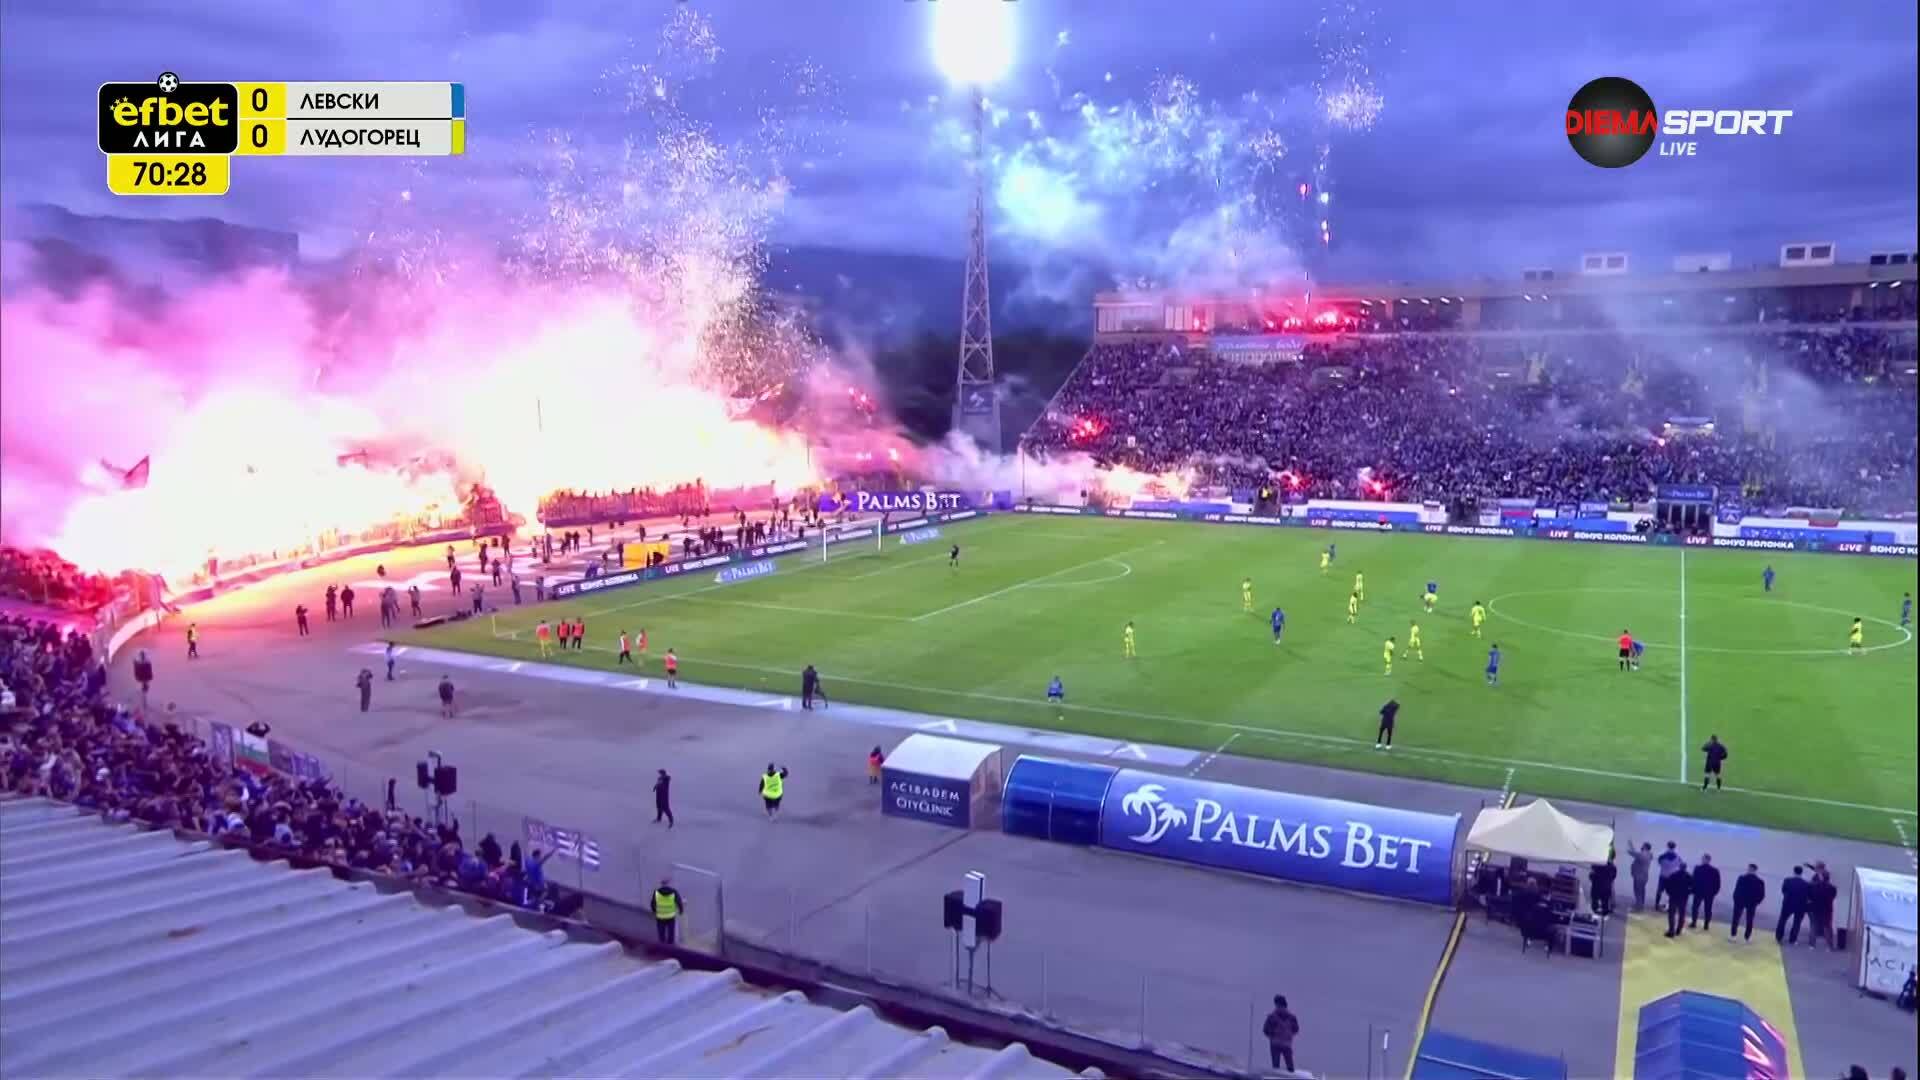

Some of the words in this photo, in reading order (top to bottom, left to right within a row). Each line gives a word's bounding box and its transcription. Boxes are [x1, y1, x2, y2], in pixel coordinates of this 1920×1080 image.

[1550, 530, 1569, 538] LIVE
[1686, 536, 1707, 545] LIVE
[1713, 538, 1745, 548] БОНУС
[1747, 539, 1795, 549] КОЛОНКА
[1839, 543, 1862, 553] LIVE
[1870, 545, 1905, 554] БОНУС
[891, 781, 960, 801] ACIBADEM
[1187, 798, 1333, 859] PALMS
[1340, 820, 1432, 874] BET
